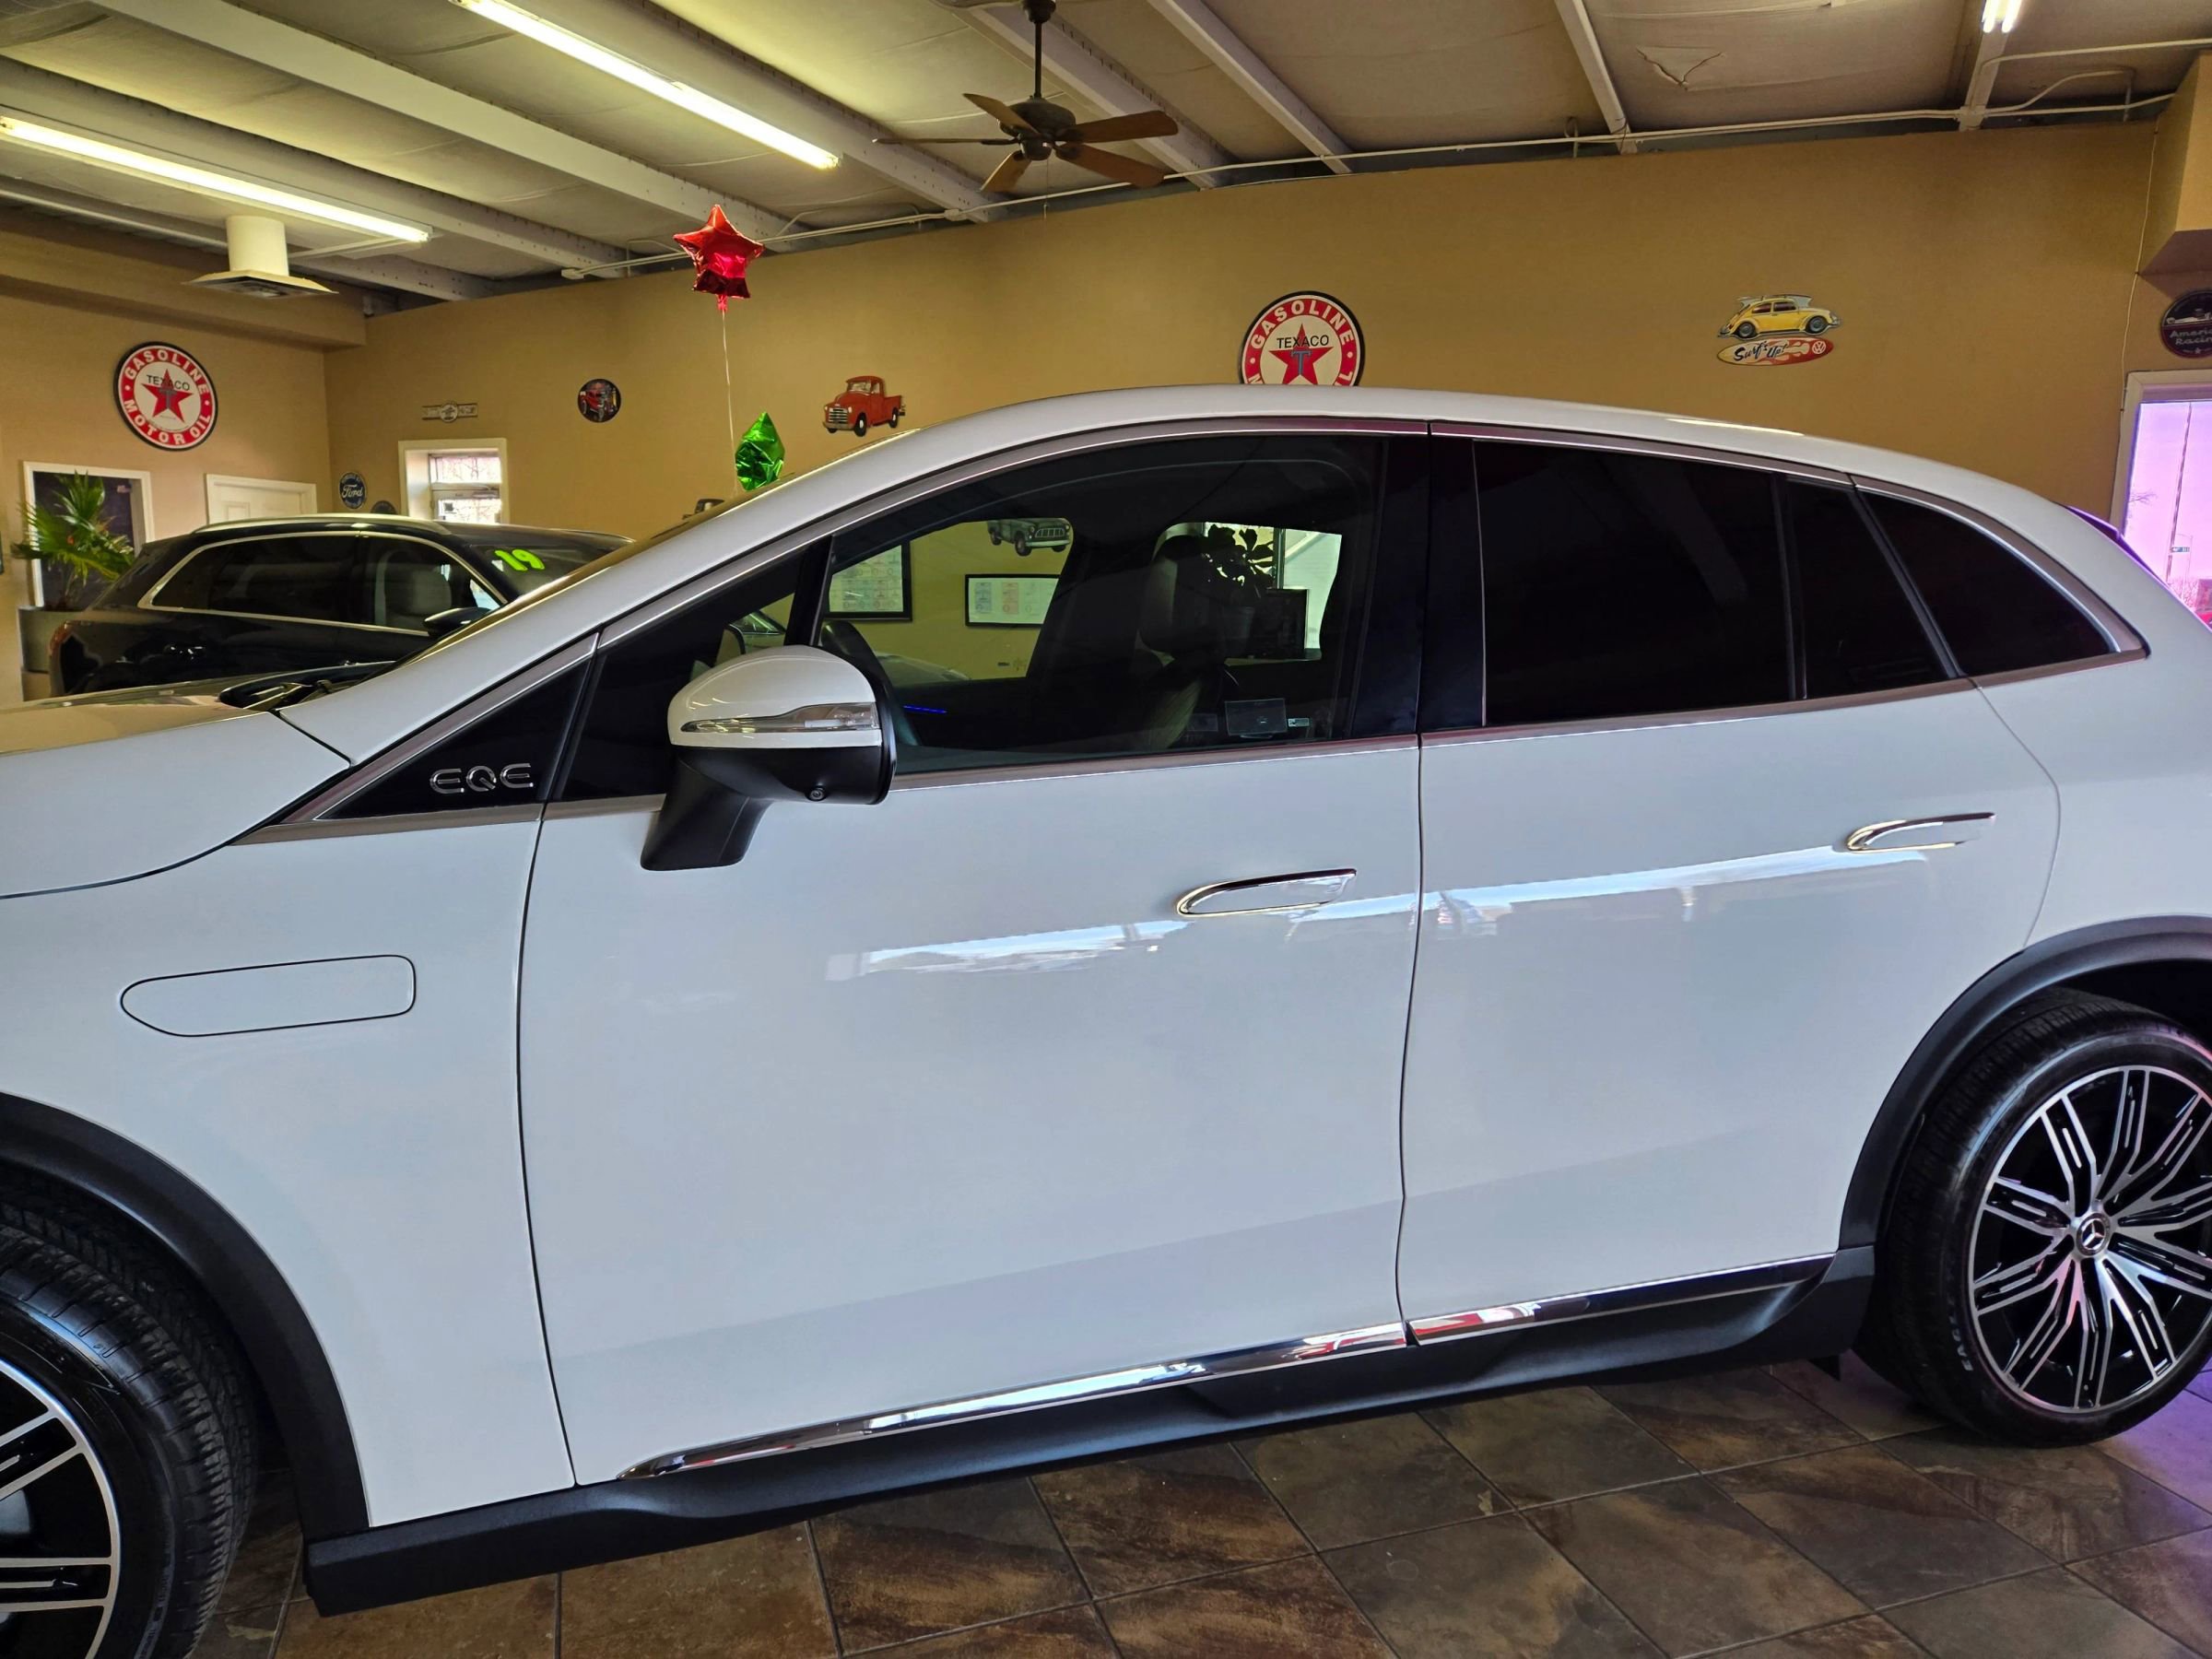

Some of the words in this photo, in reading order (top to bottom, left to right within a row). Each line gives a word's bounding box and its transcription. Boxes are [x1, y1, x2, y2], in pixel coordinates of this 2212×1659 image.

[1251, 300, 1355, 349] GASOLINE
[1277, 335, 1330, 348] TEXACO
[1734, 341, 1768, 361] Surf's
[124, 349, 209, 394] GASOLINE
[124, 399, 185, 445] MOTOR
[189, 415, 211, 439] OIL
[341, 484, 363, 499] Ford
[494, 548, 546, 571] 19
[429, 763, 534, 794] EQE
